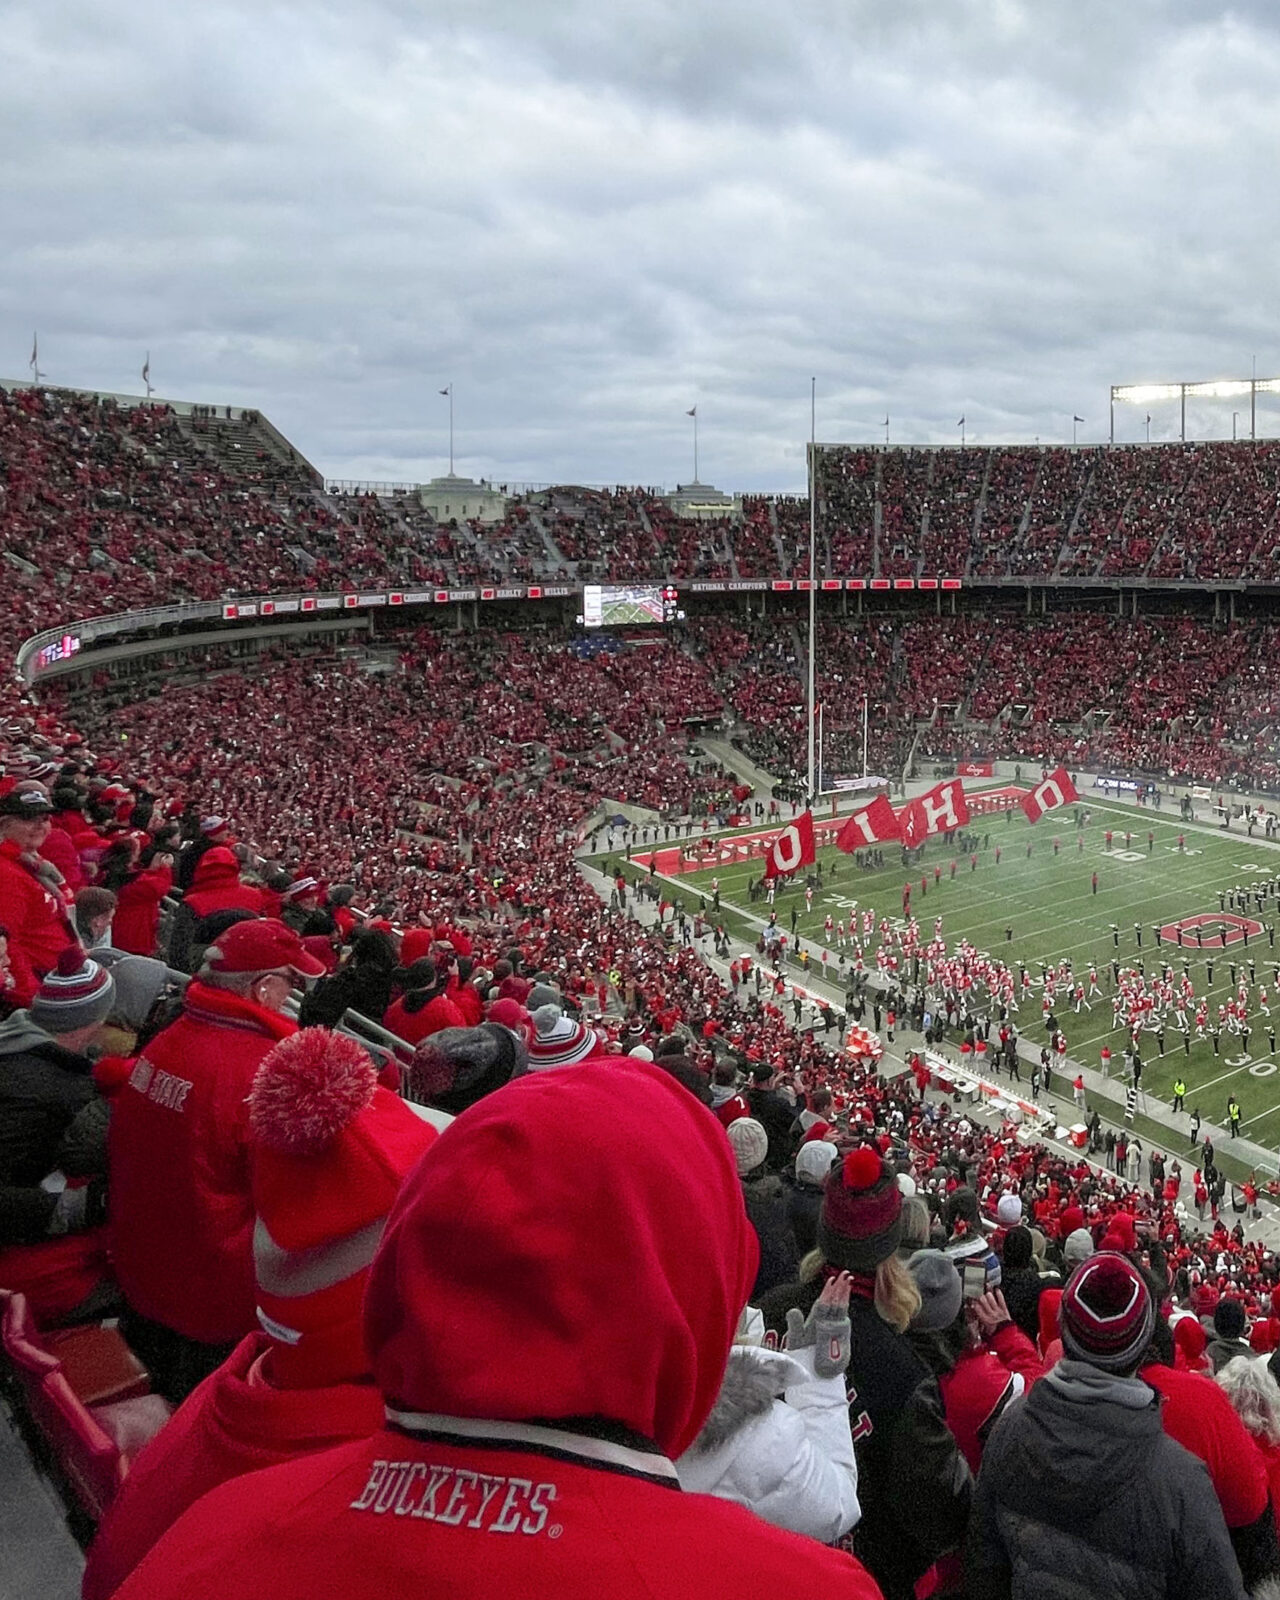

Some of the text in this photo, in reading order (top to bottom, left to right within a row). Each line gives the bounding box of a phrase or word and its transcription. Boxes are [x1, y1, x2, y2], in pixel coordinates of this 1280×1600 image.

[692, 583, 725, 591] NATIONAL
[728, 582, 768, 590] CHAMPIONS
[922, 785, 958, 834] H
[1034, 777, 1065, 813] O
[773, 824, 802, 872] O
[853, 812, 879, 845] I
[822, 892, 858, 909] 20
[149, 1069, 194, 1112] STATE
[350, 1459, 557, 1535] BUCKEYES
